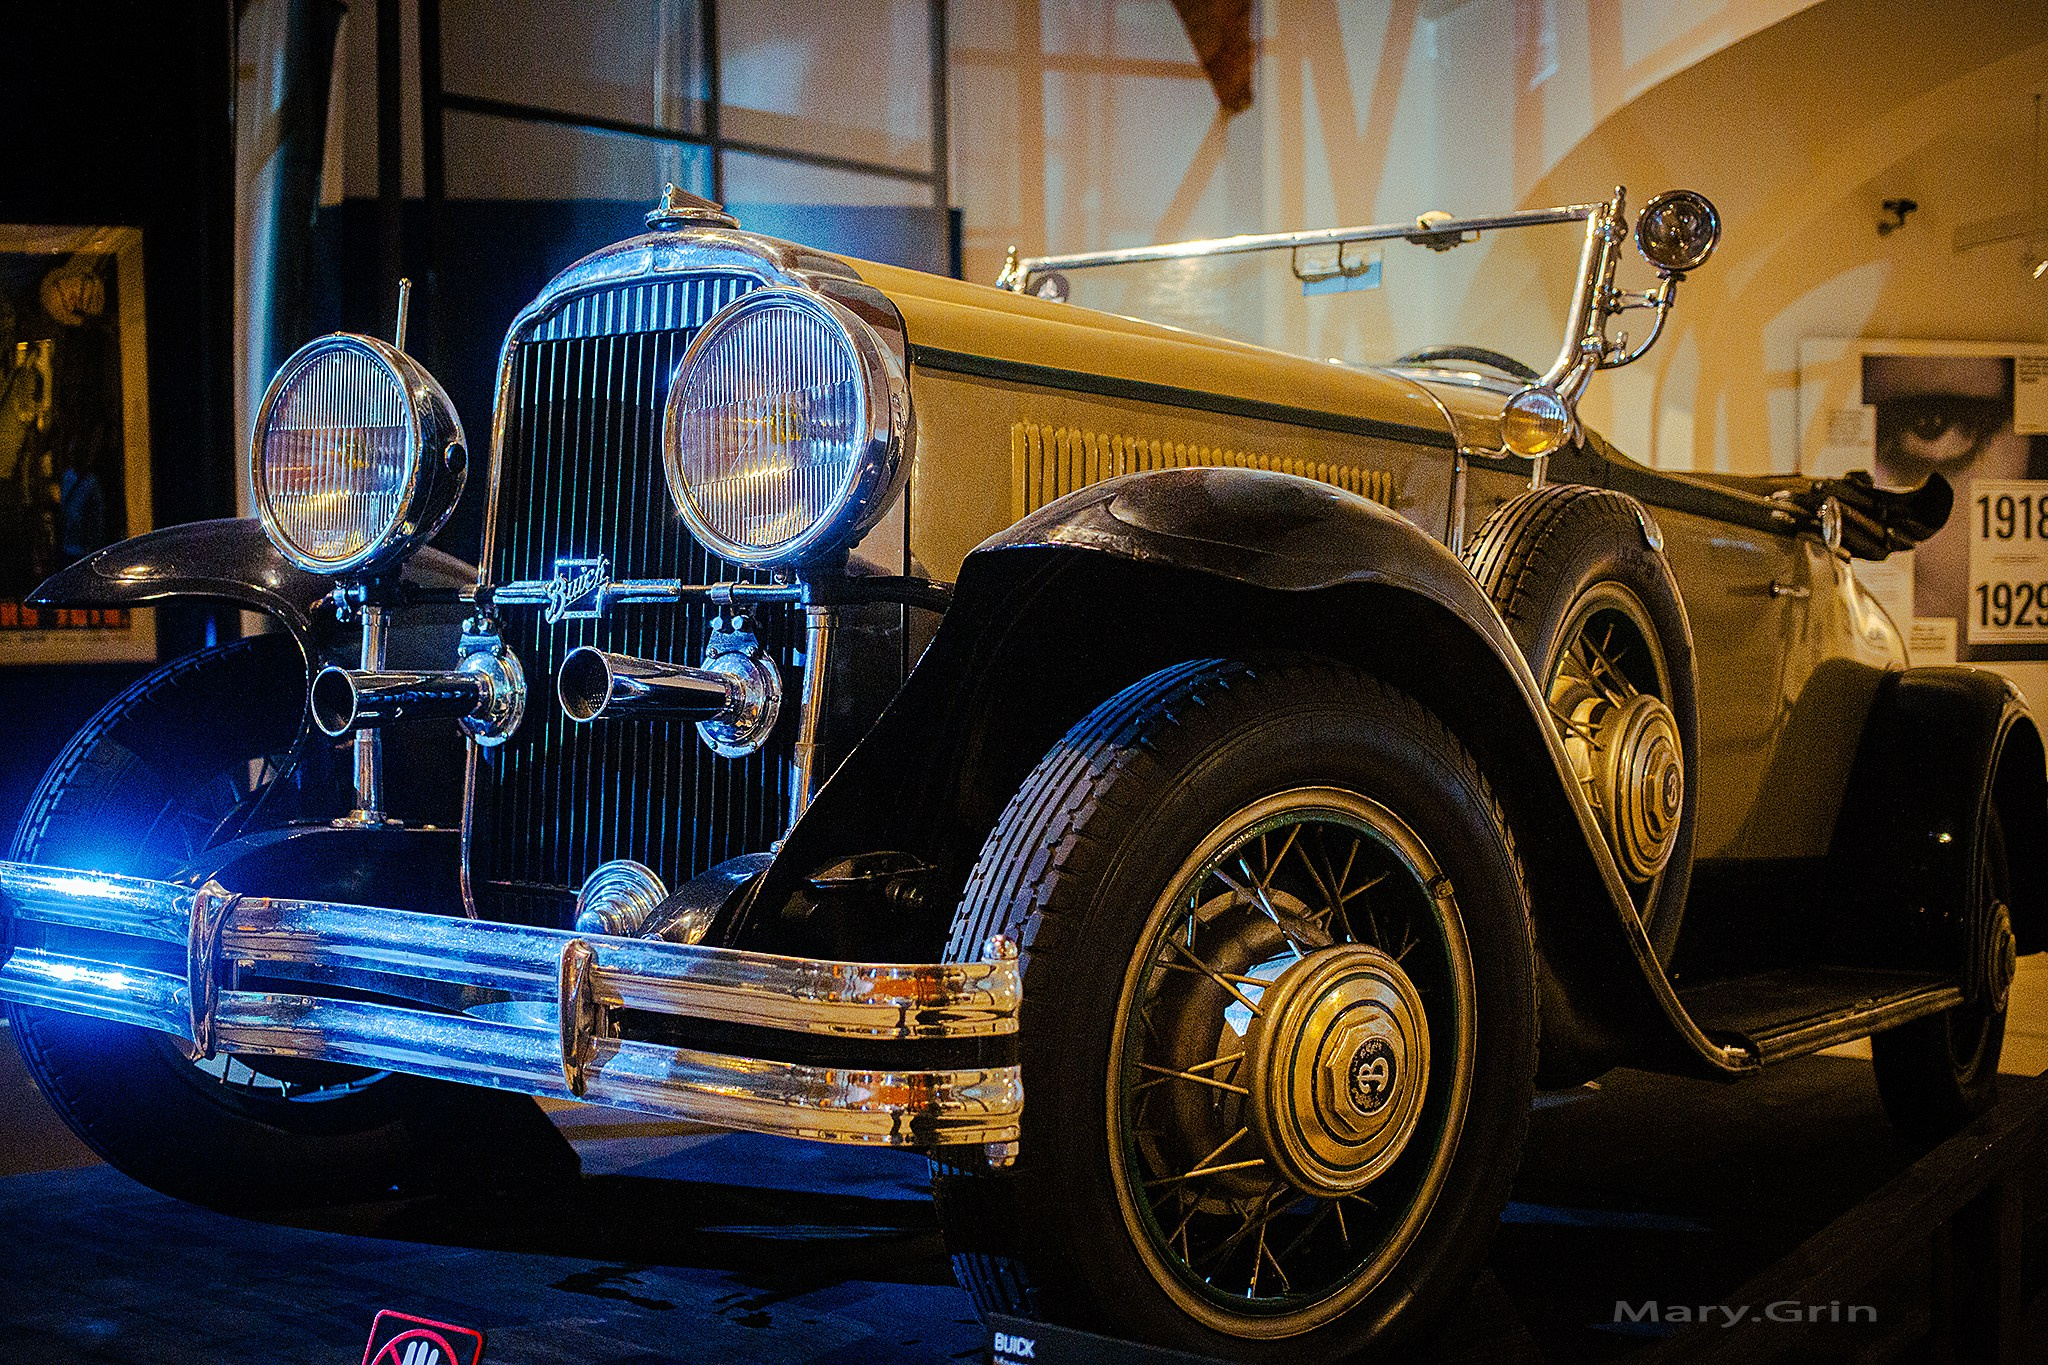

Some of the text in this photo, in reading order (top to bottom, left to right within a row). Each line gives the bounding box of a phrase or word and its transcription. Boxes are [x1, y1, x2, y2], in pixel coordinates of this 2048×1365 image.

[1977, 495, 2048, 539] 1918
[543, 553, 609, 624] Buick
[994, 1331, 1036, 1359] BUICK
